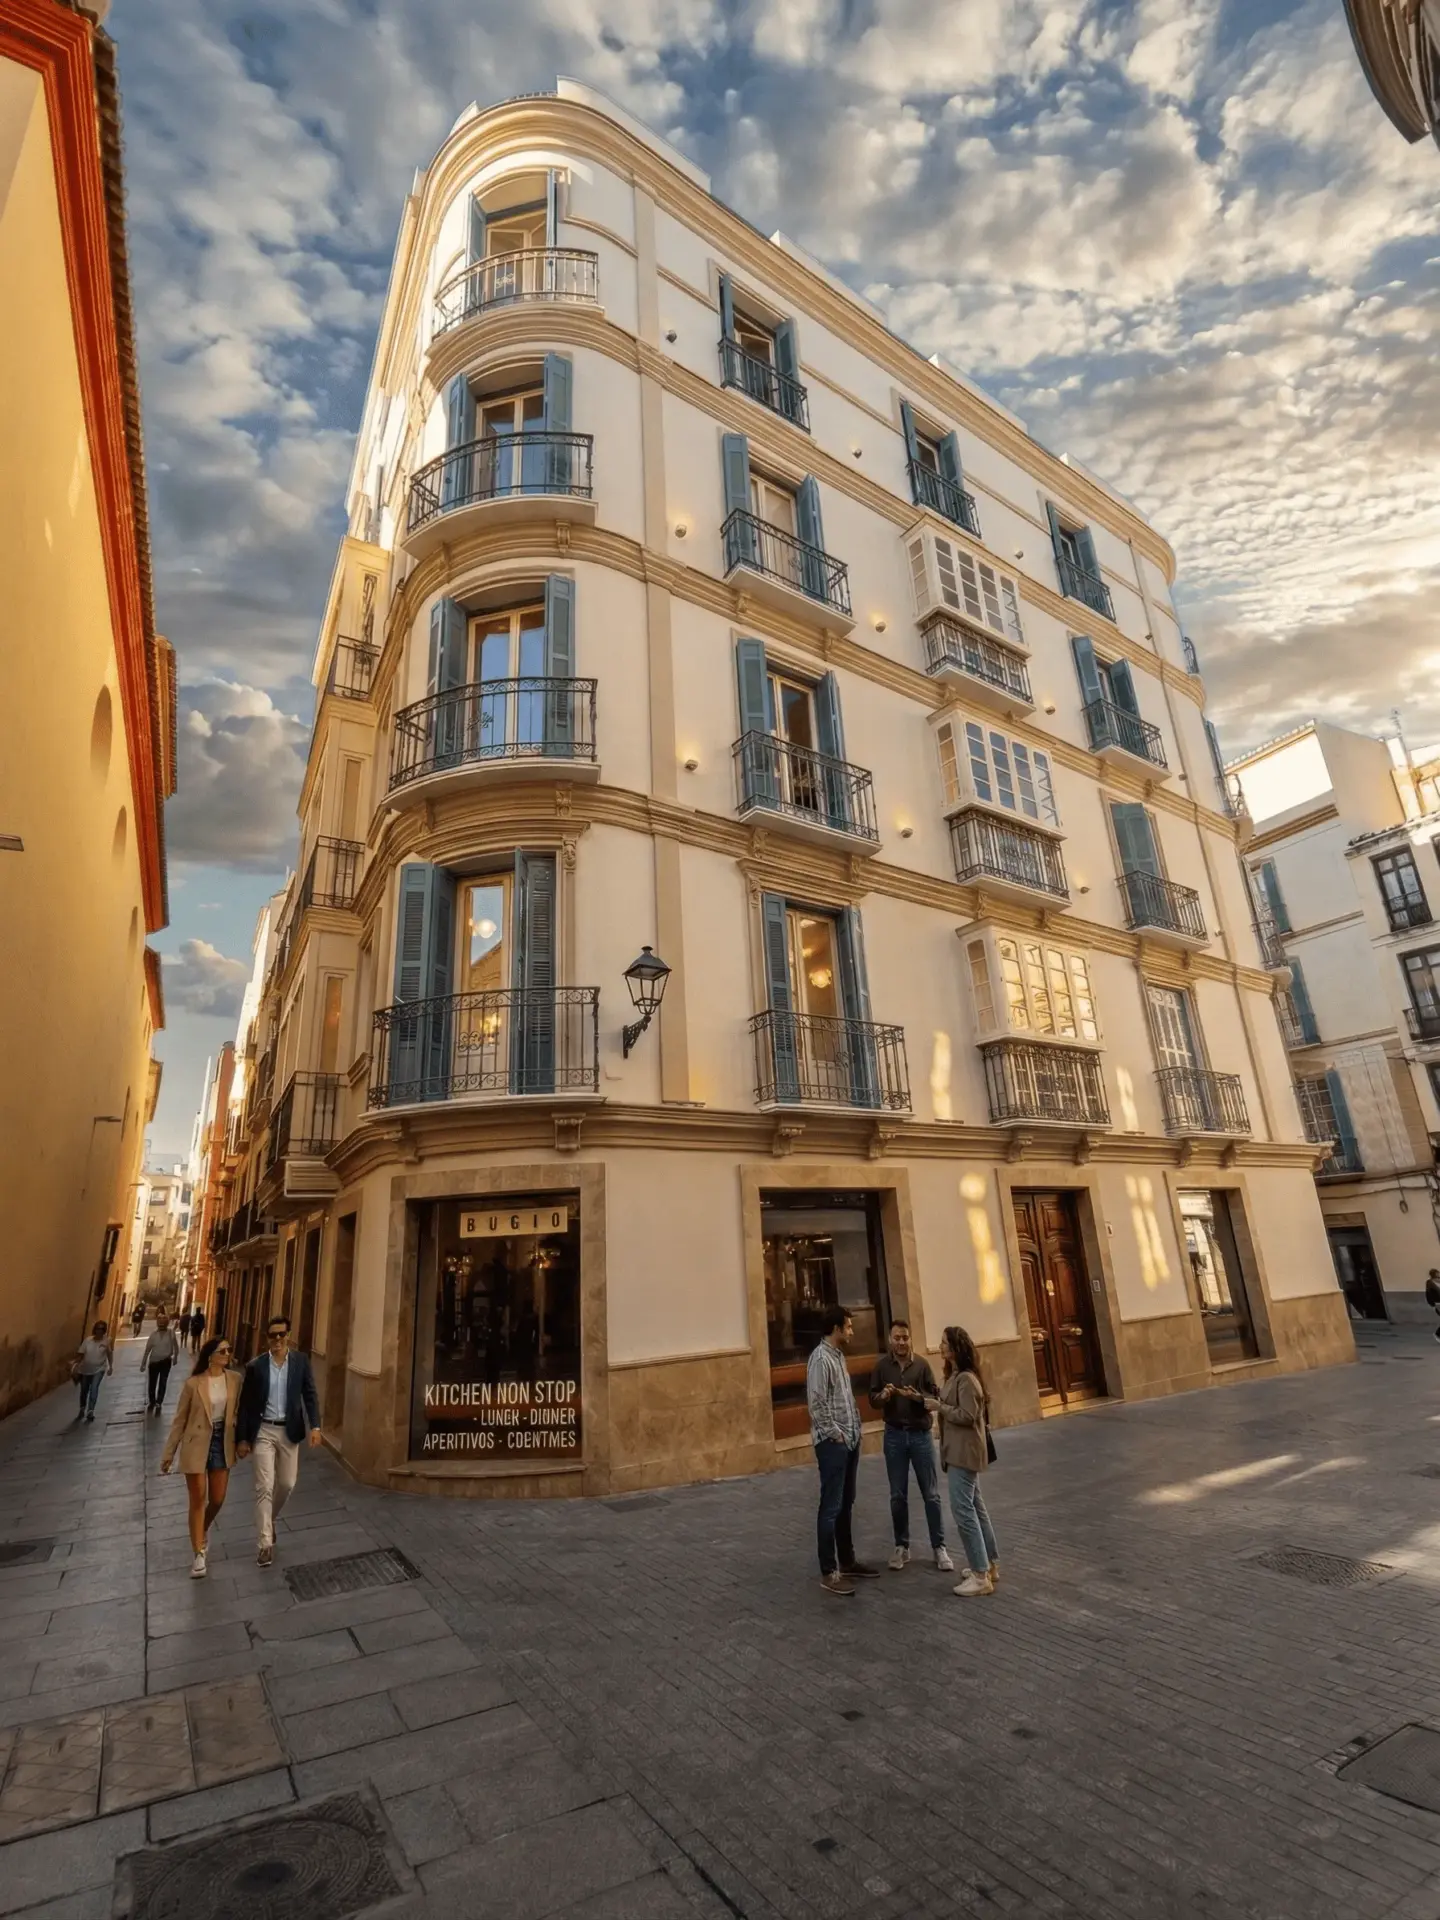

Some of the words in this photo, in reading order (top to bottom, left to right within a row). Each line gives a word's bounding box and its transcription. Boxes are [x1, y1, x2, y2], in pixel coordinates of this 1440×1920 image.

[466, 1212, 560, 1232] BUGIO
[424, 1382, 492, 1406] KITCHEN
[497, 1381, 530, 1405] NON
[534, 1380, 576, 1403] STOP
[422, 1431, 495, 1451] APERITIVOS
